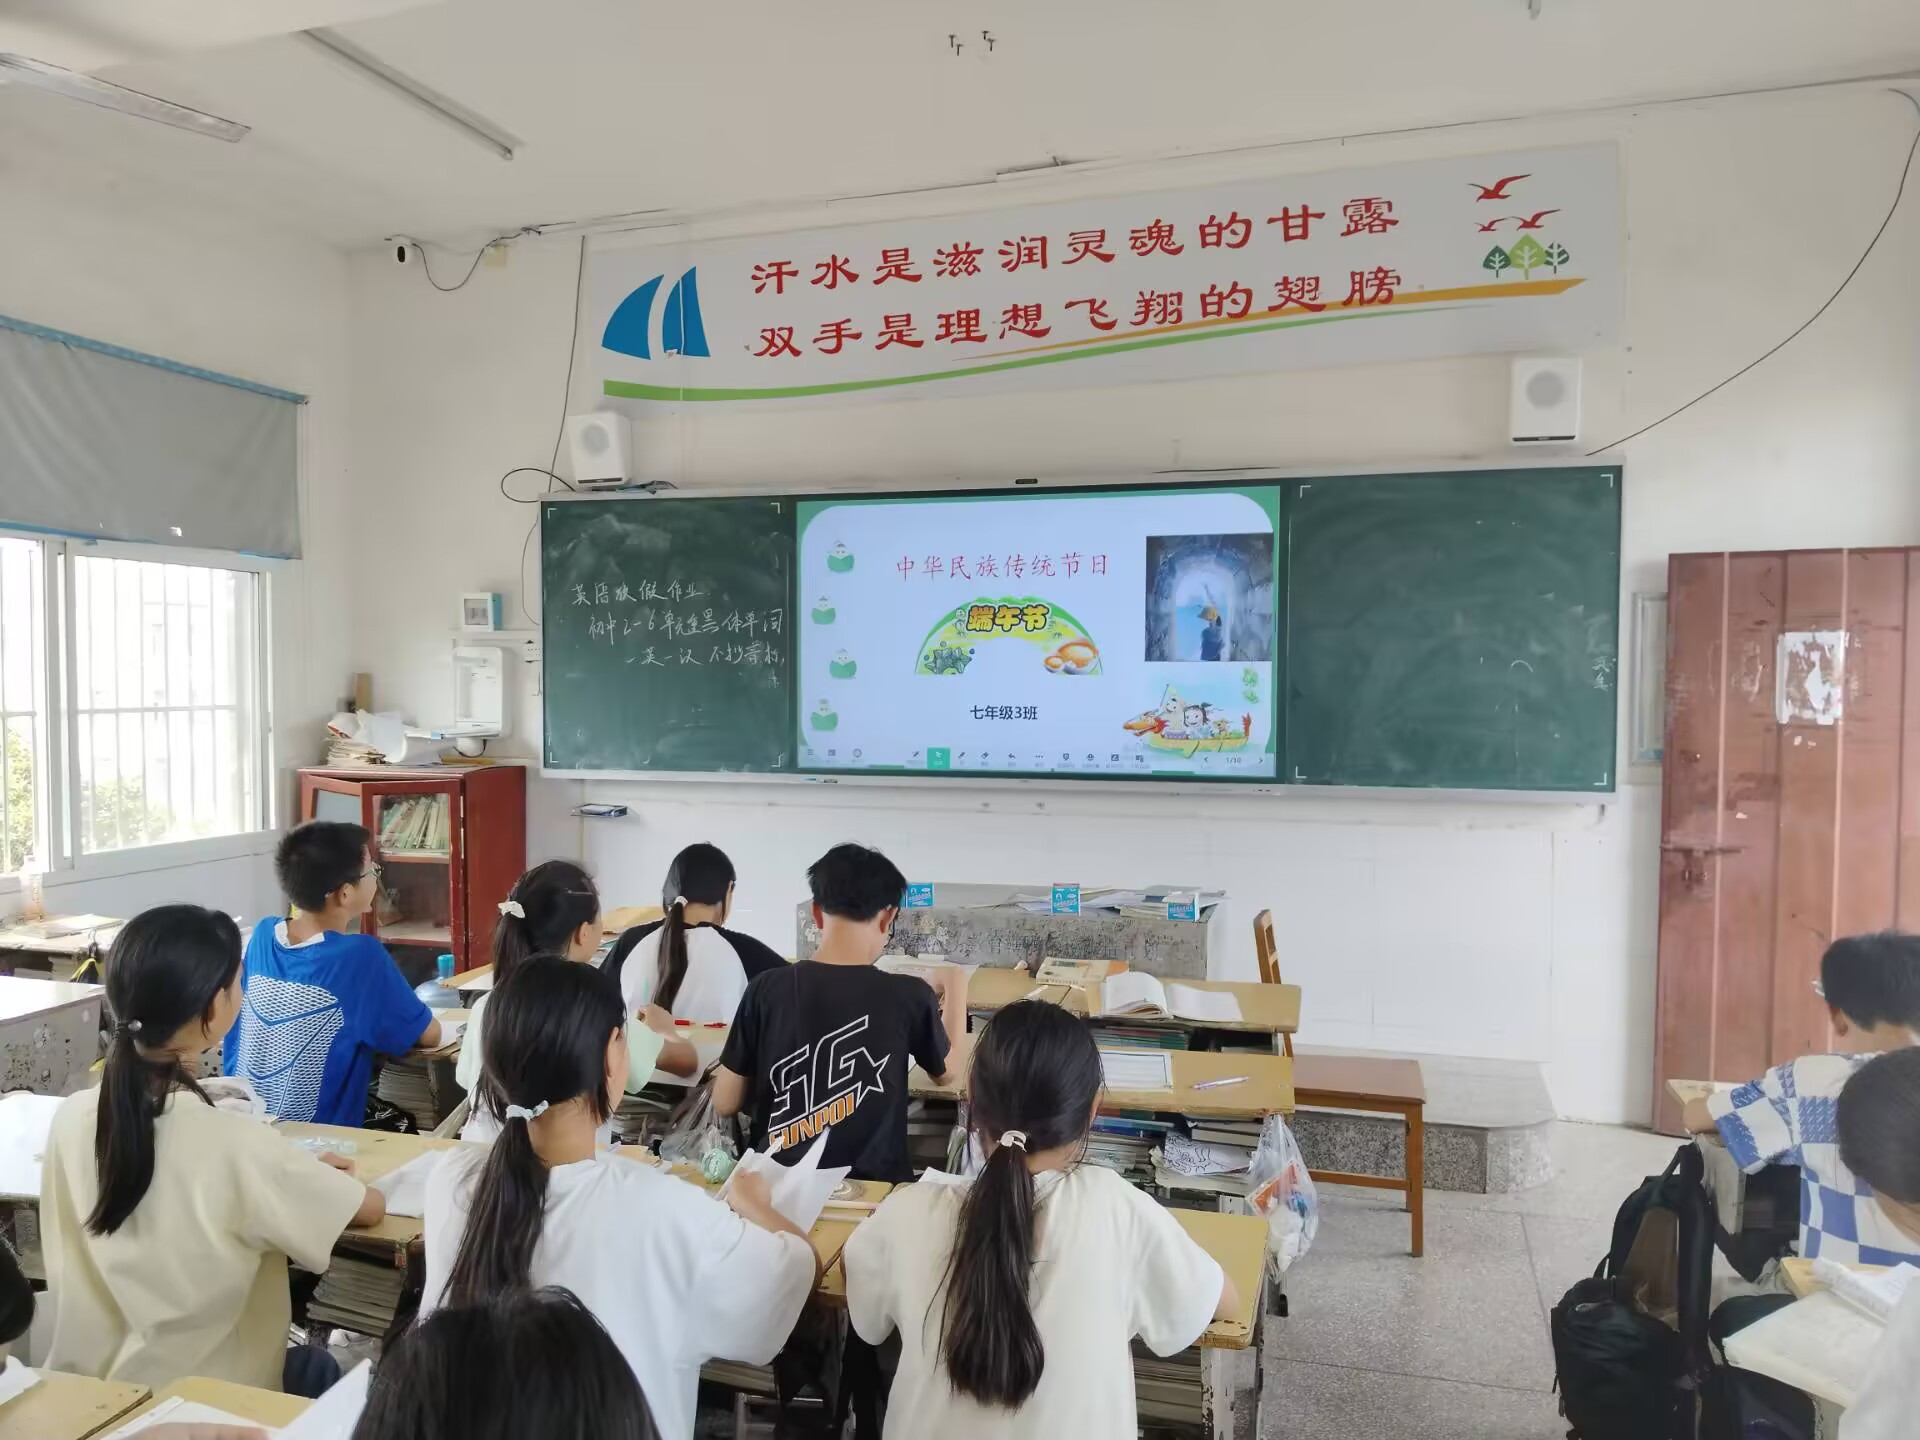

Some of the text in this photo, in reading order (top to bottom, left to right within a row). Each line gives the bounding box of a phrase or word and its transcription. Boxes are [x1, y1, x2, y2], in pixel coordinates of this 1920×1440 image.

[751, 198, 1399, 295] 汗水是滋润灵魂的甘露
[753, 267, 1402, 358] 双手是理想飞翔的翅膀
[897, 552, 1107, 581] 中华民族传统节日
[966, 604, 1050, 632] 端午节
[970, 704, 1038, 720] 七年级3班
